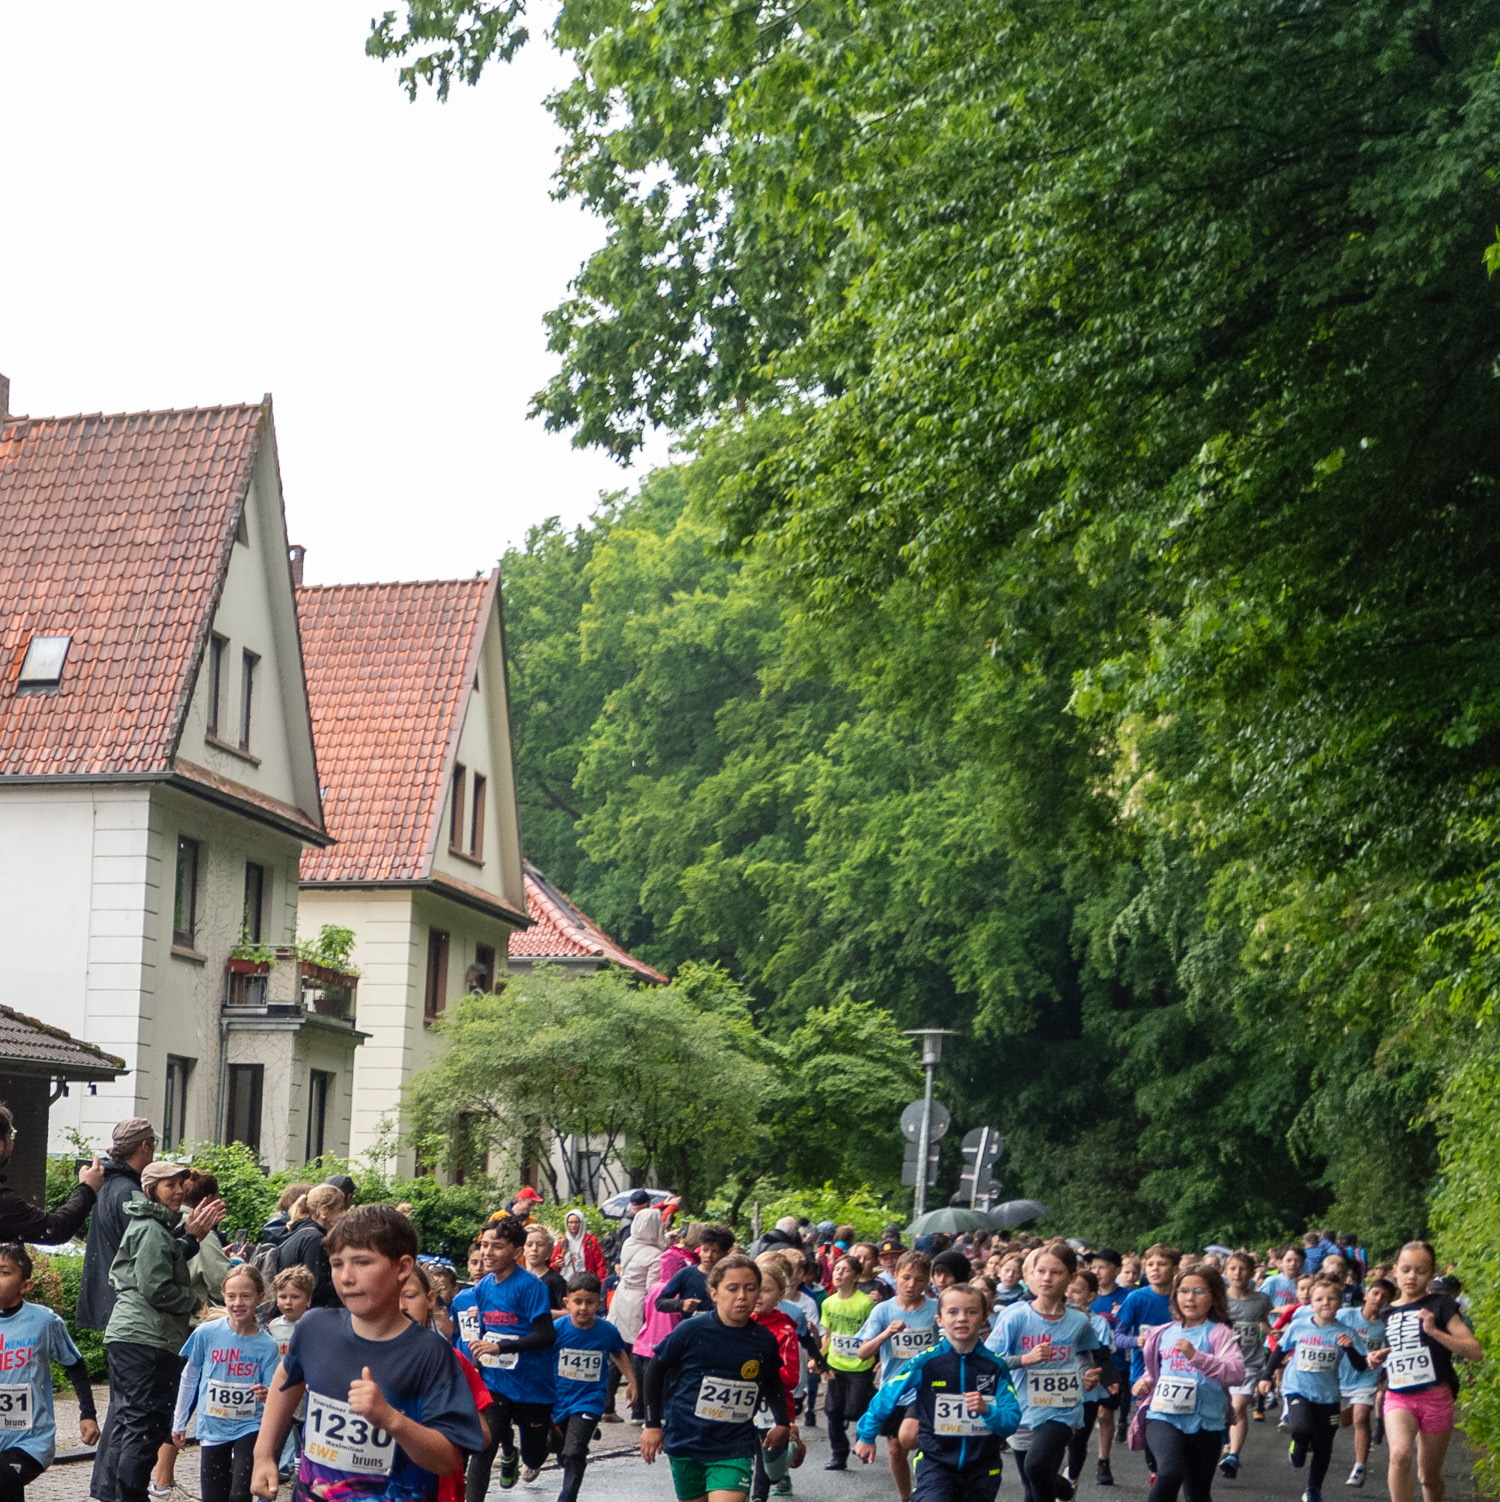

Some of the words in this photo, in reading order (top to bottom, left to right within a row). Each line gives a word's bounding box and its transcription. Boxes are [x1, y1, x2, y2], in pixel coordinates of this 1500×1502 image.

[832, 1337, 861, 1349] 1514
[892, 1332, 933, 1347] 1902
[211, 1347, 240, 1364] RUN
[561, 1354, 600, 1369] 1419
[1300, 1349, 1337, 1362] 1895
[226, 1361, 258, 1377] HES!
[1388, 1354, 1430, 1374] 1579
[1030, 1376, 1079, 1392] 1884
[1156, 1382, 1195, 1400] 1877
[209, 1387, 255, 1405] 1892
[700, 1385, 757, 1406] 2415
[4, 1417, 27, 1428] bruns
[310, 1408, 393, 1448] 1230
[308, 1442, 339, 1463] EWE
[352, 1453, 384, 1468] bruns
